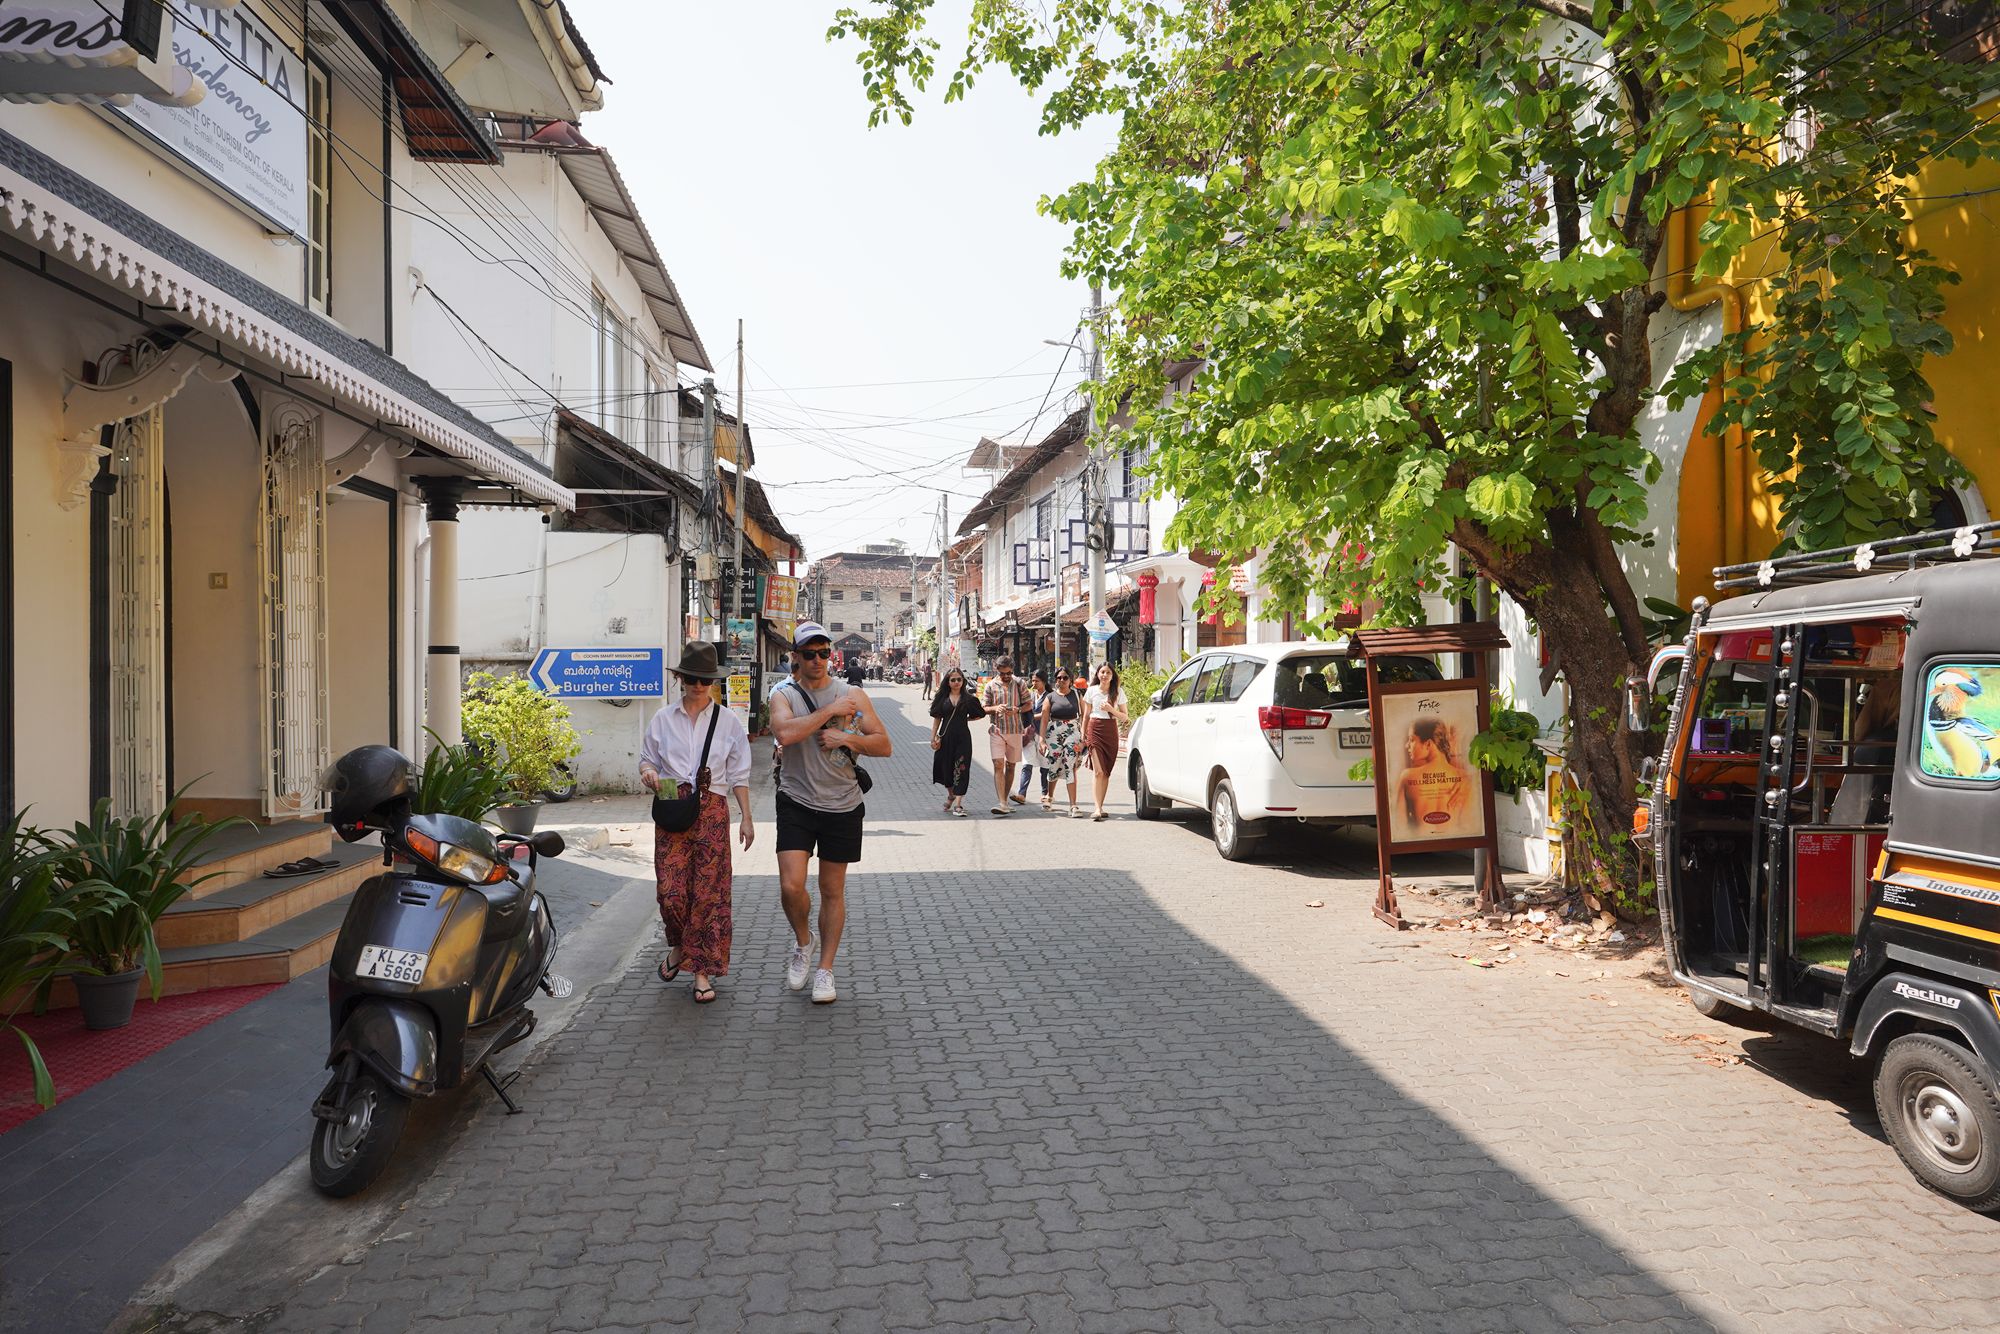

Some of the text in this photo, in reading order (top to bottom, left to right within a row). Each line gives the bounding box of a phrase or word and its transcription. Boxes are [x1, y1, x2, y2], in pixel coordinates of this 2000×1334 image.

[172, 41, 272, 143] esidency
[200, 114, 211, 128] OF
[212, 121, 242, 154] TOURISM
[262, 161, 271, 178] OF
[271, 168, 295, 194] KERALA
[771, 589, 792, 599] 50%
[771, 600, 790, 609] Flat
[563, 680, 660, 694] Burgher Street
[1418, 698, 1440, 712] Forte
[1348, 734, 1371, 745] KL07
[1436, 776, 1462, 784] MATTERS
[400, 880, 435, 891] HONDA
[378, 948, 395, 964] KL
[399, 952, 417, 967] 43
[368, 962, 422, 983] A 5860
[1893, 982, 1961, 1009] Racing
